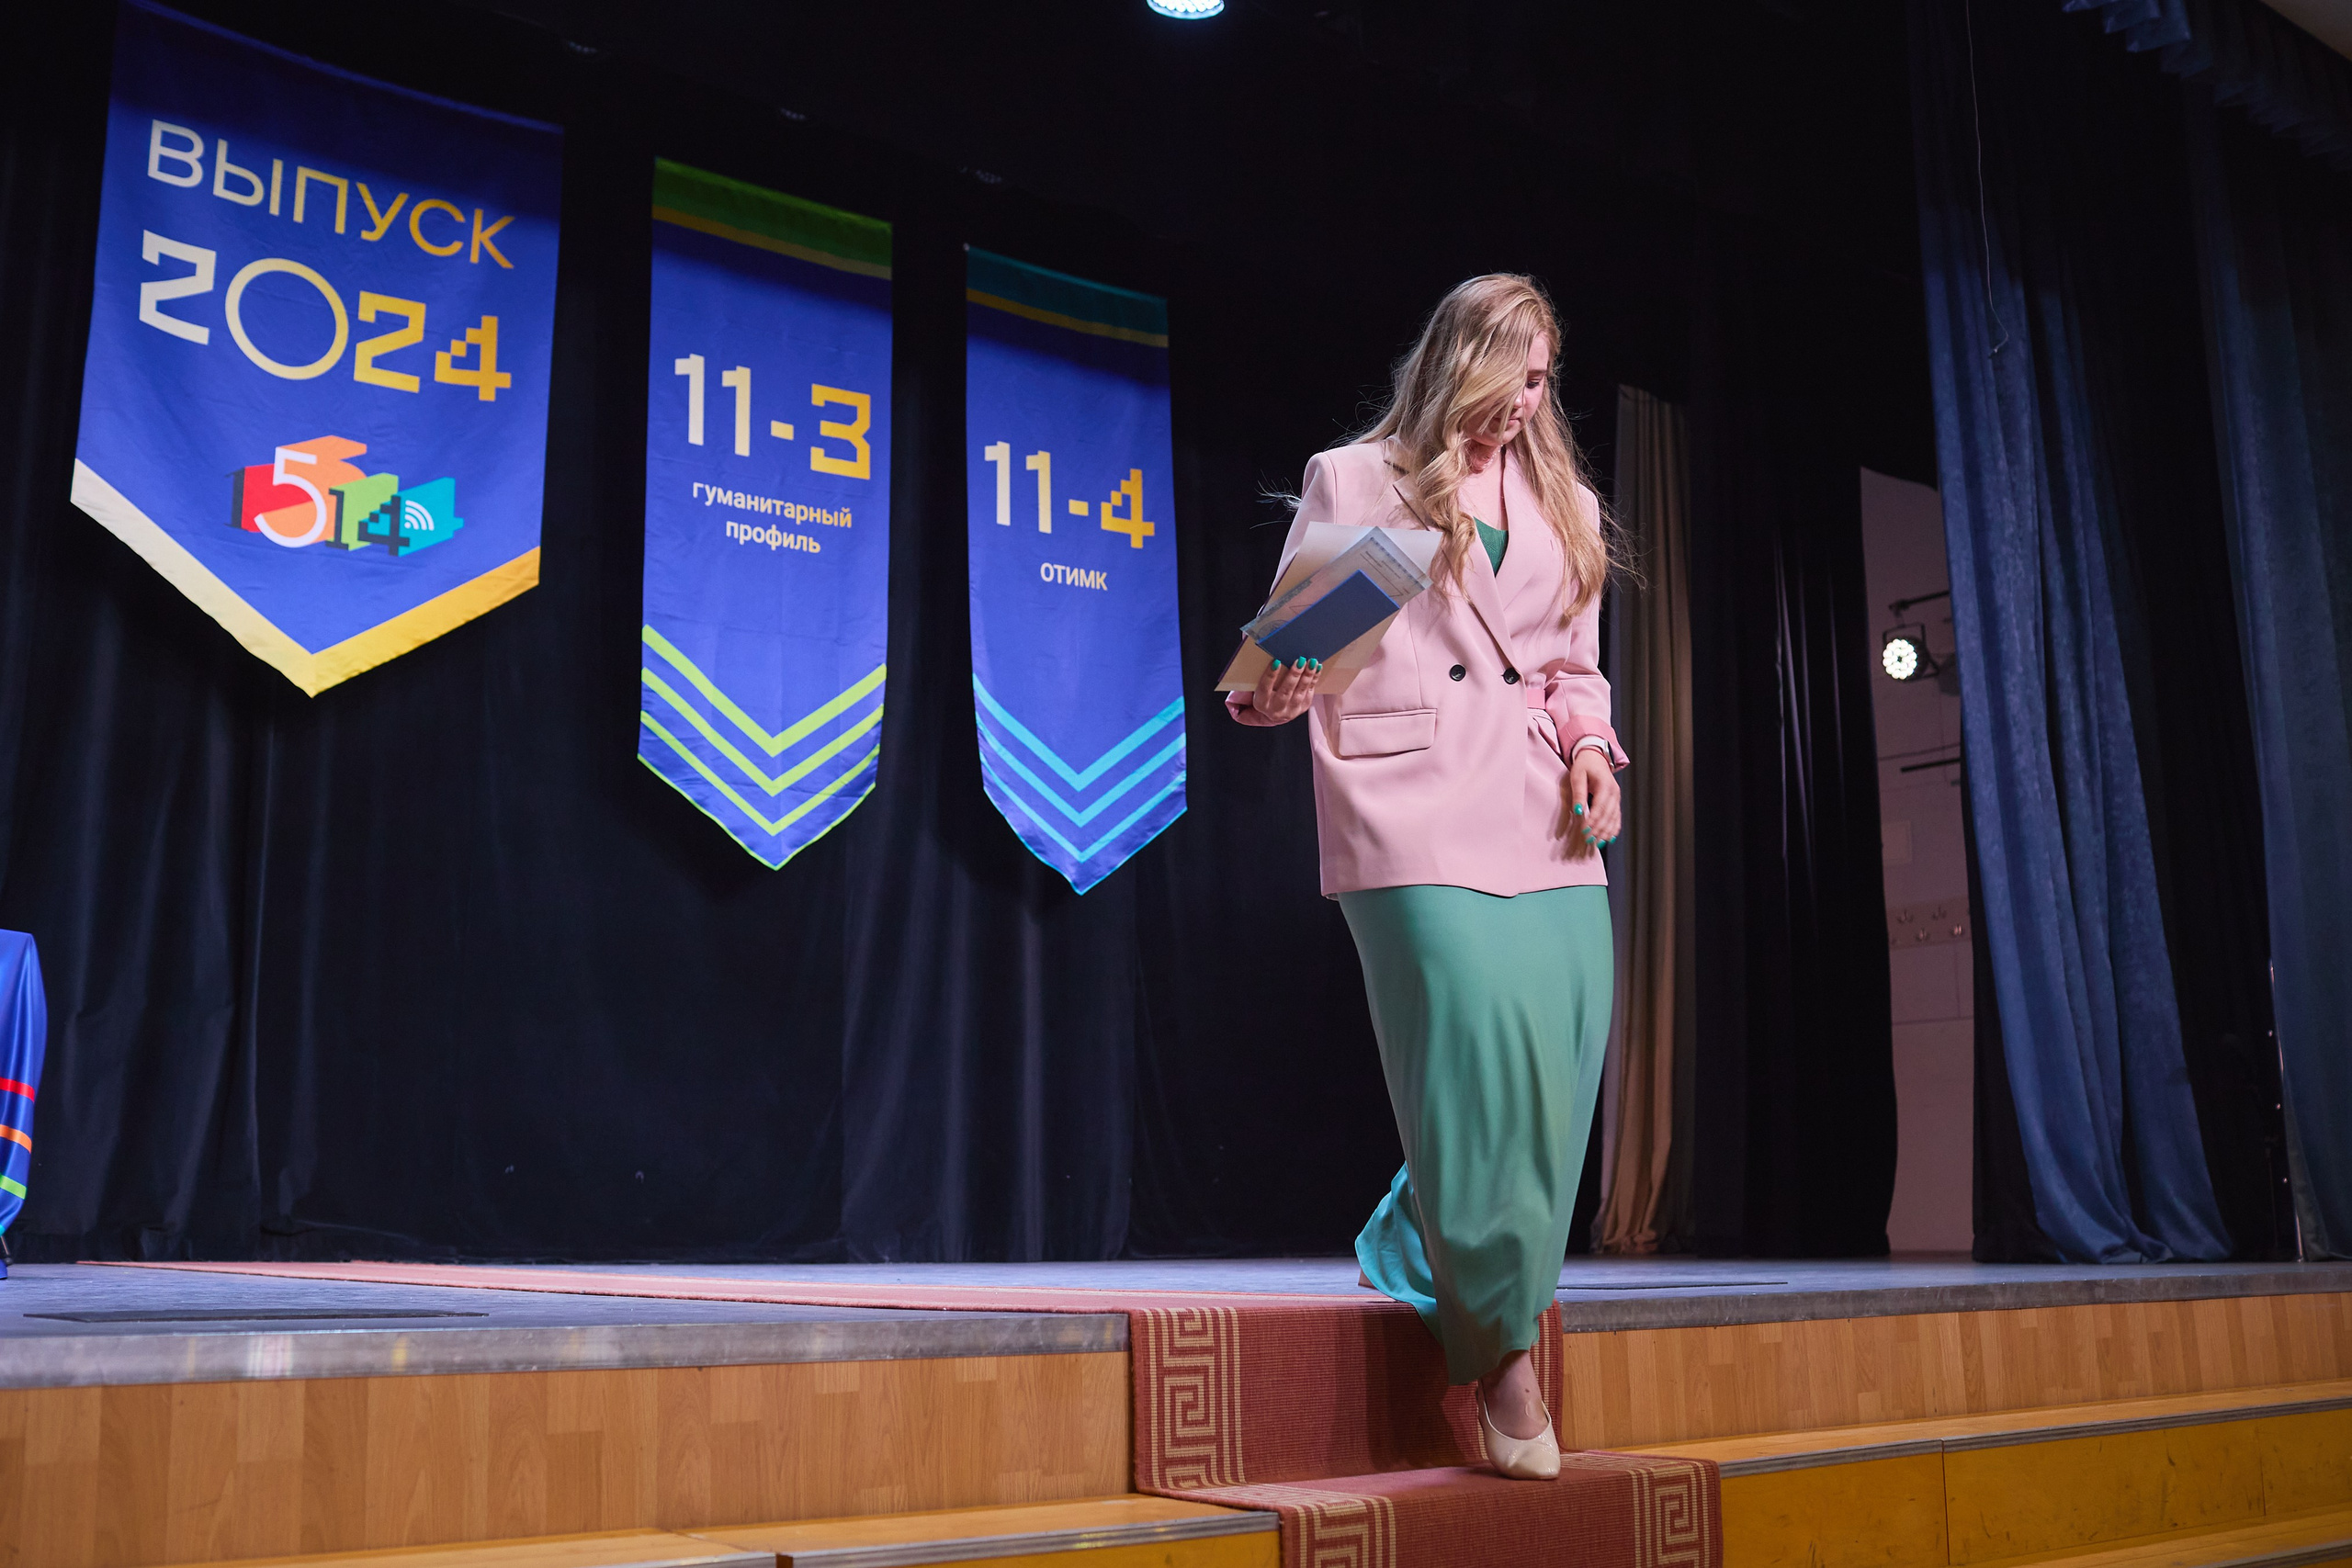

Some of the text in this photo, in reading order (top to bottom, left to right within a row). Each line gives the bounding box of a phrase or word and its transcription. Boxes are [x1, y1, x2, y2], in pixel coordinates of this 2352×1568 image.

[147, 119, 514, 268] ВЫПУСК
[139, 230, 512, 401] 2024
[674, 354, 871, 480] 11-3
[693, 481, 853, 528] гуманитарный
[726, 521, 821, 551] профиль
[984, 441, 1155, 548] 11-4
[1040, 562, 1108, 591] ОТИМК
